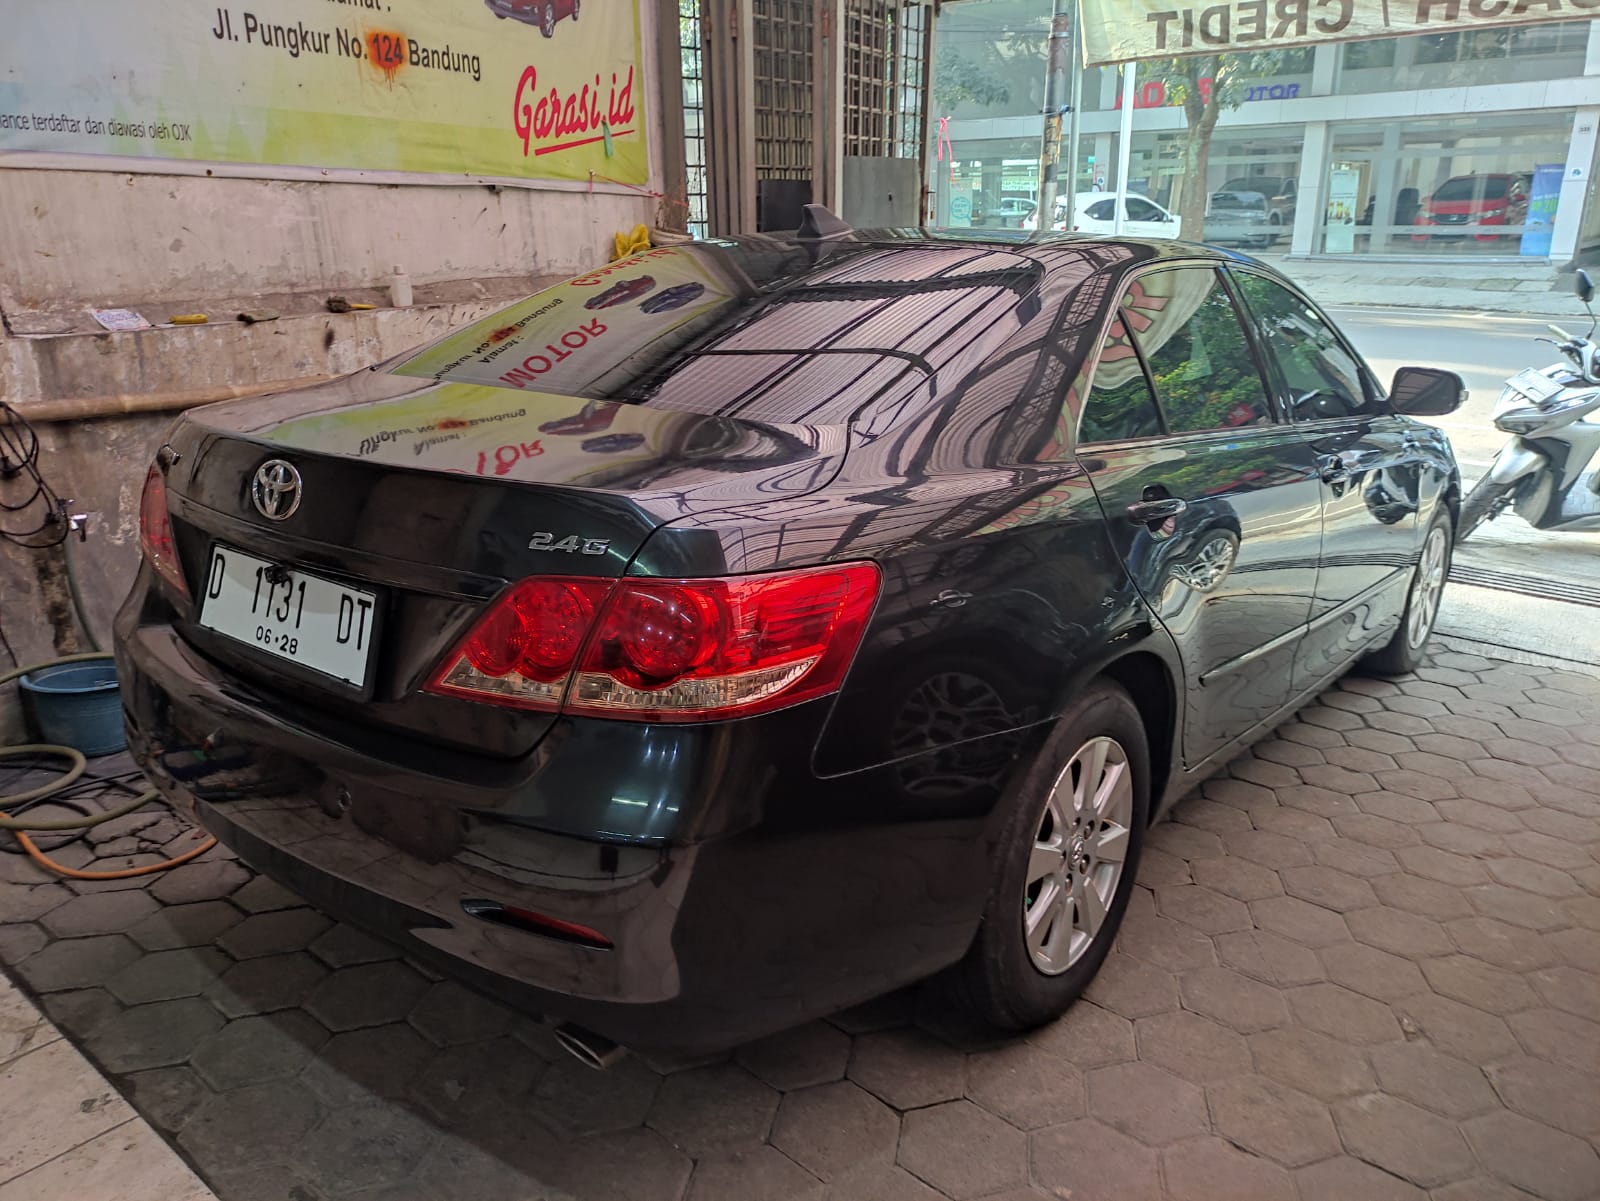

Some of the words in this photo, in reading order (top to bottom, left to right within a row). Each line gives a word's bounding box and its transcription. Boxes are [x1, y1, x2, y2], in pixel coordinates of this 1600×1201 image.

[212, 8, 239, 42] Jl.
[243, 12, 331, 58] Pungkur
[336, 27, 368, 60] No.
[373, 33, 404, 64] 124
[407, 39, 481, 82] Bandung
[31, 112, 81, 133] terdaftar
[84, 115, 106, 136] dan
[108, 118, 147, 138] diawasi
[149, 121, 169, 140] oleh
[171, 123, 193, 142] OJK
[513, 65, 635, 158] Garasi.id
[209, 553, 226, 599] D
[251, 567, 307, 629] 1131
[336, 593, 372, 651] DT
